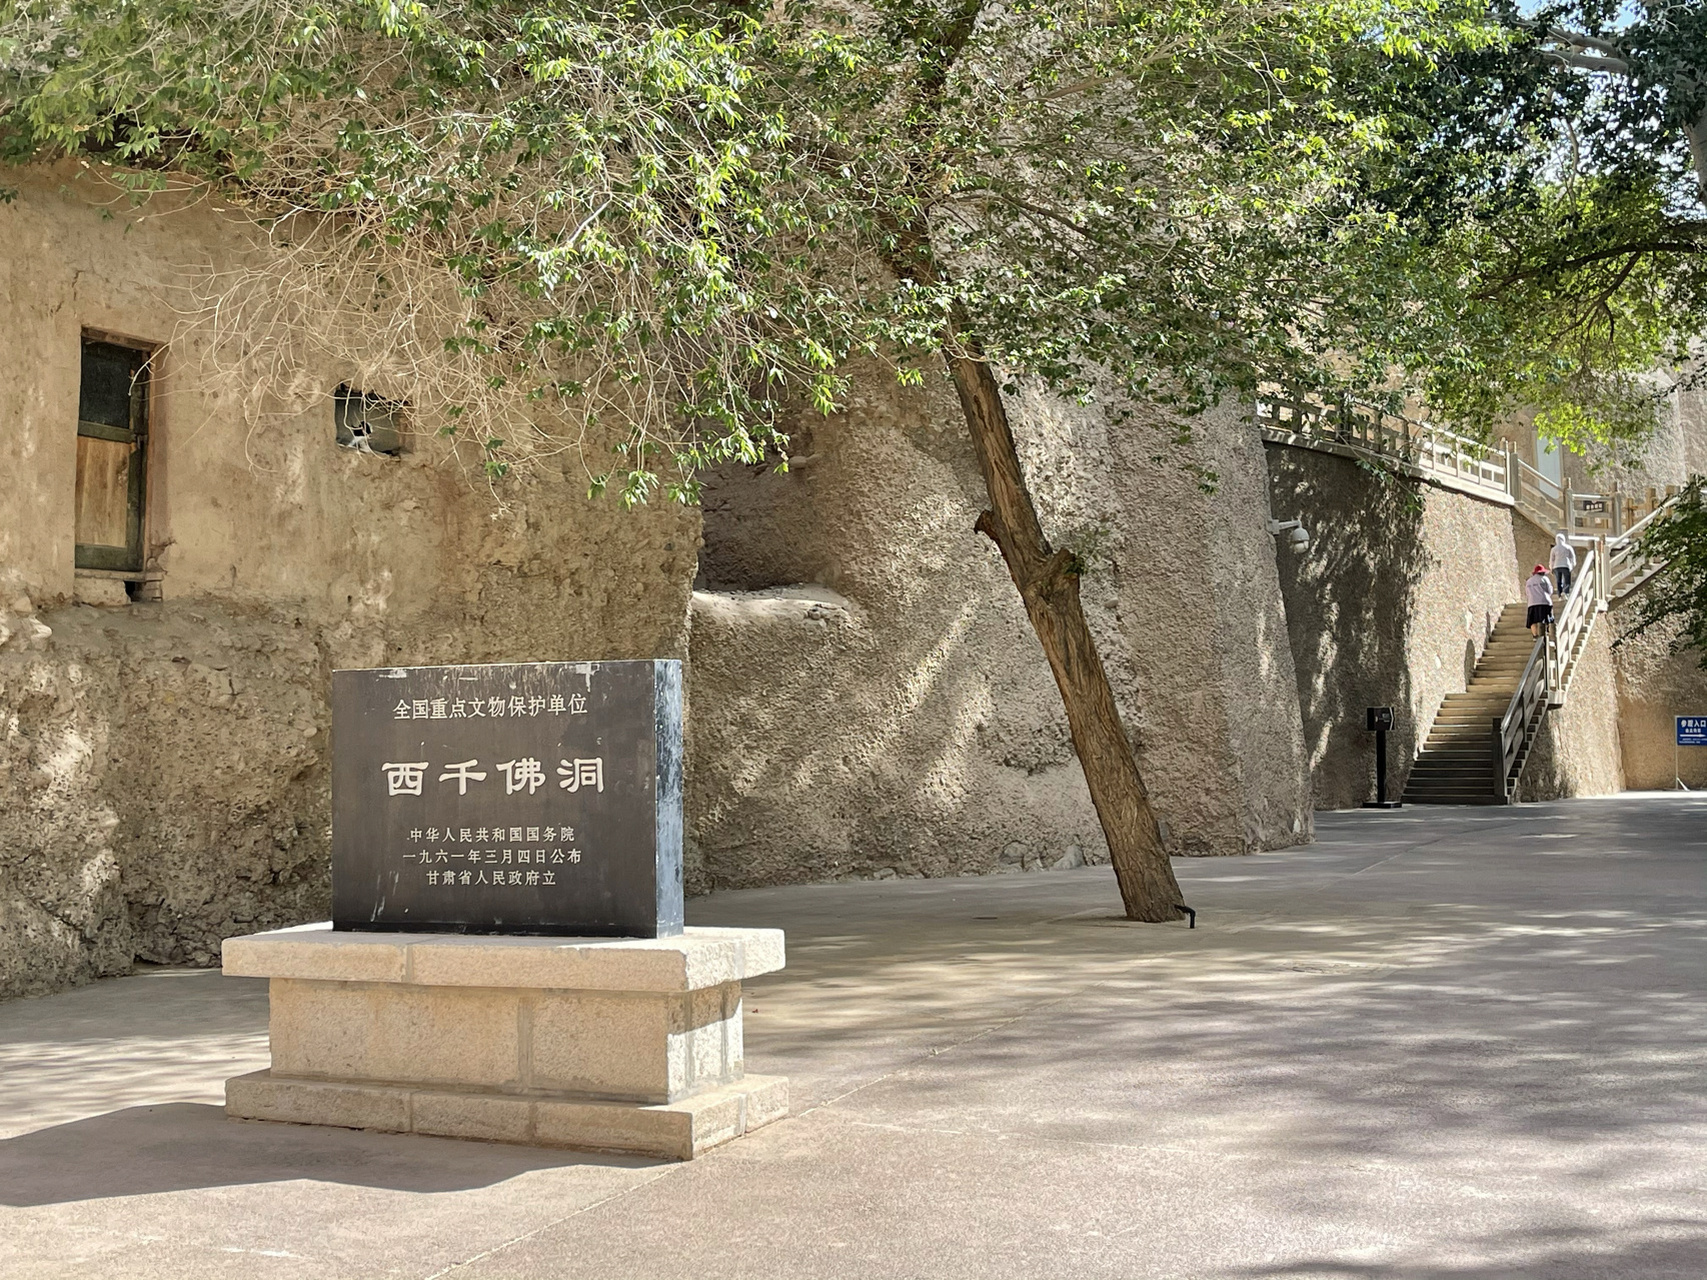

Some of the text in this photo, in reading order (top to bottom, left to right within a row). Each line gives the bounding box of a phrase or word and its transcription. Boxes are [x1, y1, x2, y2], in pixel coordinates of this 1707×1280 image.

[392, 693, 588, 720] 全国重点文物保护单位
[381, 757, 605, 796] 西千佛洞
[410, 826, 575, 843] 中华人民共和国国务院
[402, 848, 582, 865] 一九六一年三月四日公布
[425, 870, 556, 886] 甘肃省人民政府立
